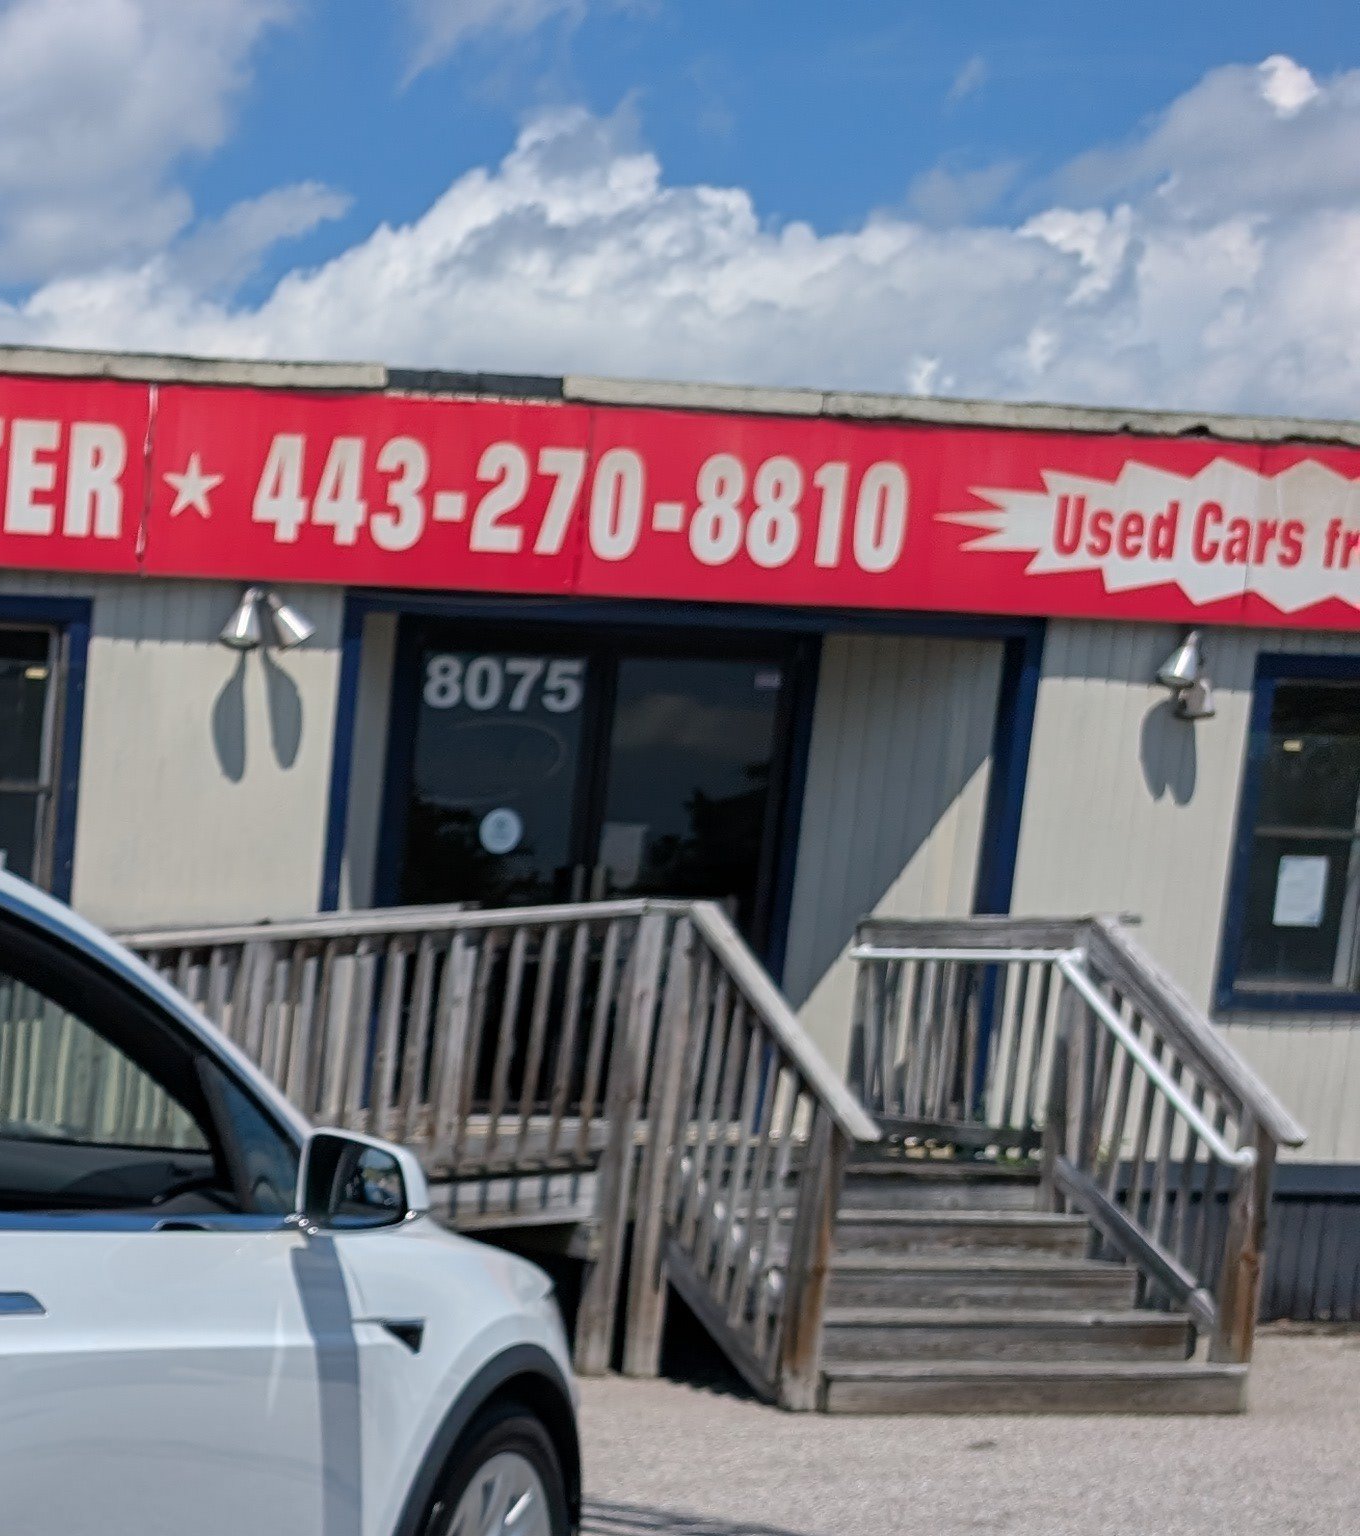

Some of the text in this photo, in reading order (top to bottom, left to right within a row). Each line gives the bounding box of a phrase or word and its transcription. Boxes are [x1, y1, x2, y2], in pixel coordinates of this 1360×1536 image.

[252, 434, 908, 572] 443-270-8810
[1054, 494, 1181, 560] Used
[1192, 501, 1305, 567] Cars
[423, 654, 586, 713] 8075
